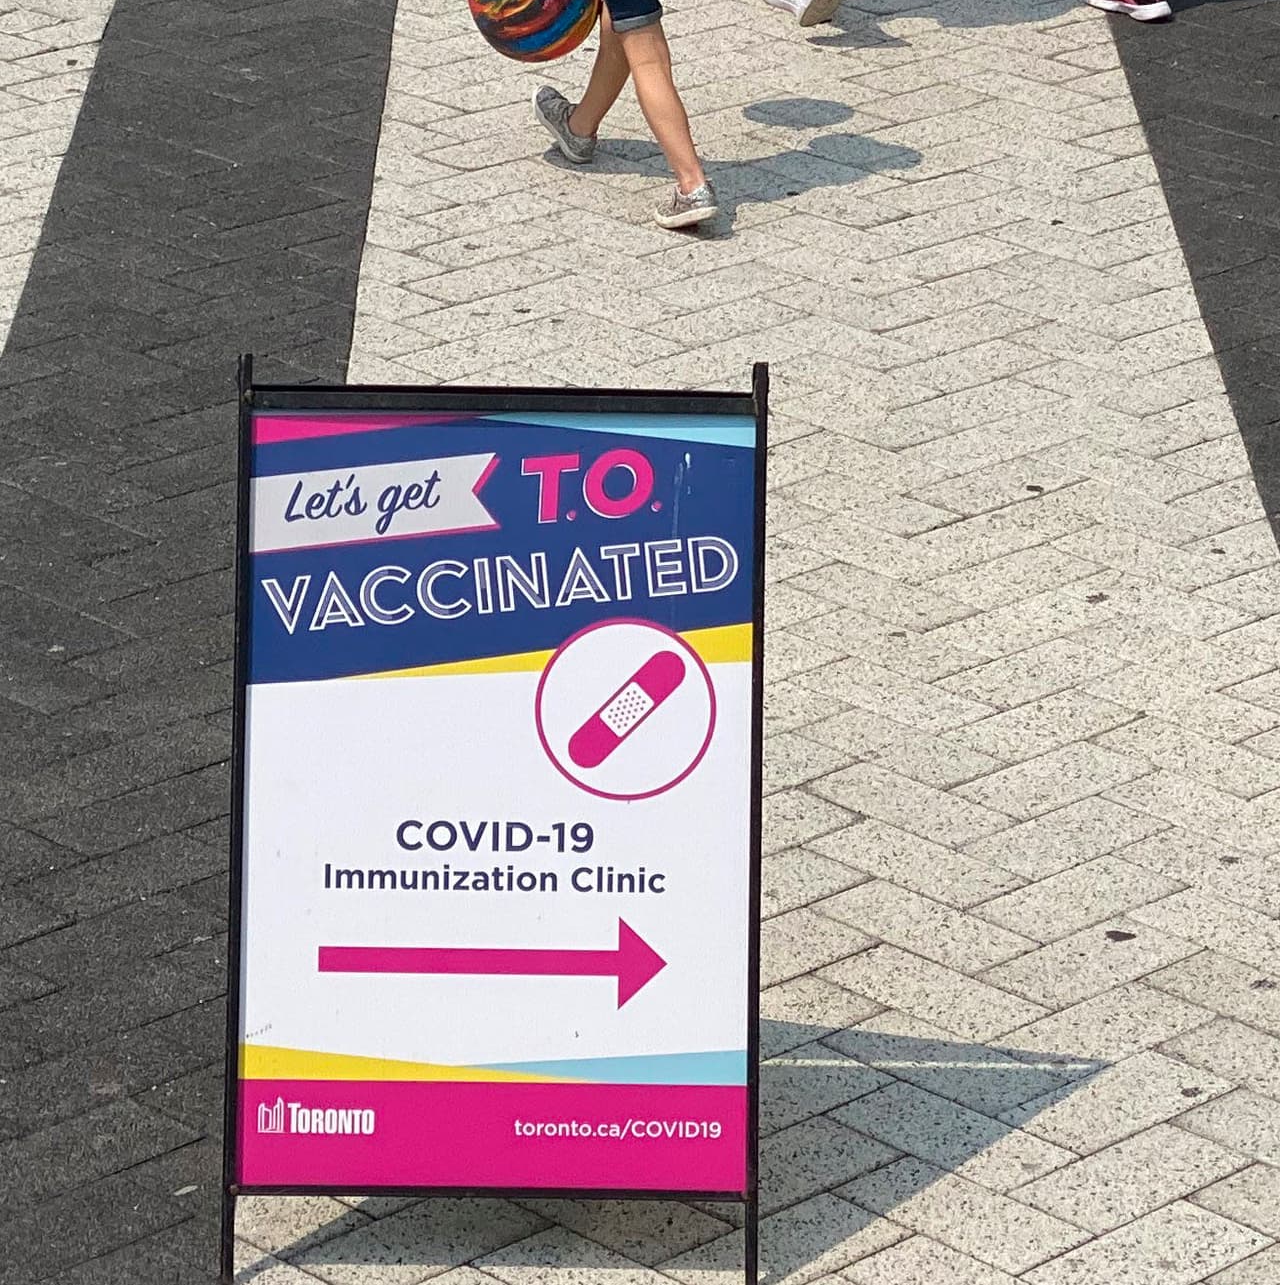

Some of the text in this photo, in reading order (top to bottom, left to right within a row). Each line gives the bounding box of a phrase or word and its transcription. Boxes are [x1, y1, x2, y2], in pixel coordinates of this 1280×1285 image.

[284, 448, 663, 535] Let's get T.O.
[261, 536, 739, 634] VACCINATED
[396, 819, 595, 853] COVID-19
[323, 863, 666, 894] Immunization Clinic
[288, 1101, 722, 1139] TORONTO toronto.ca/COVID19
